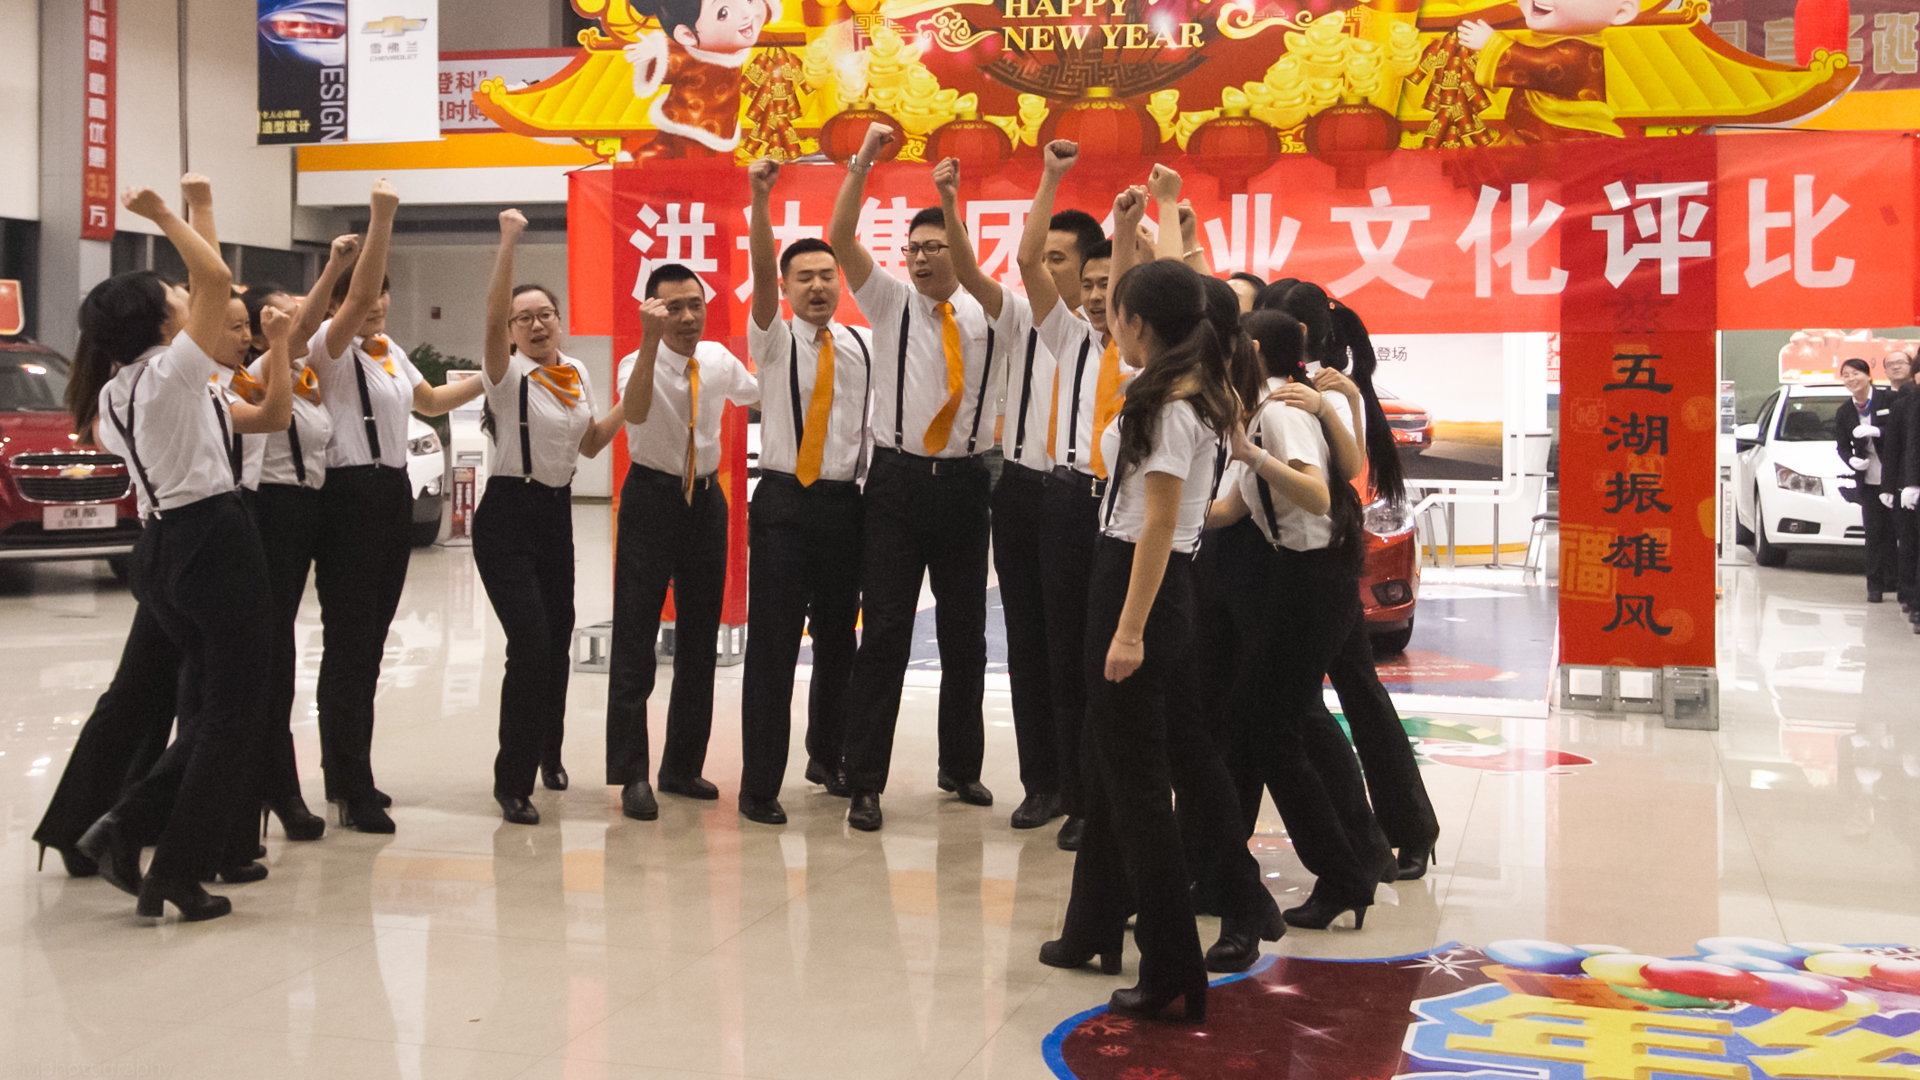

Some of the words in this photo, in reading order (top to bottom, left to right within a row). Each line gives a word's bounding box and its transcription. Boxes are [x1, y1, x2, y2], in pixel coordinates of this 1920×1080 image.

[1001, 0, 1127, 18] HAPPY
[1001, 25, 1092, 51] NEW
[1099, 22, 1205, 50] YEAR
[369, 53, 418, 62] CHEVROLET
